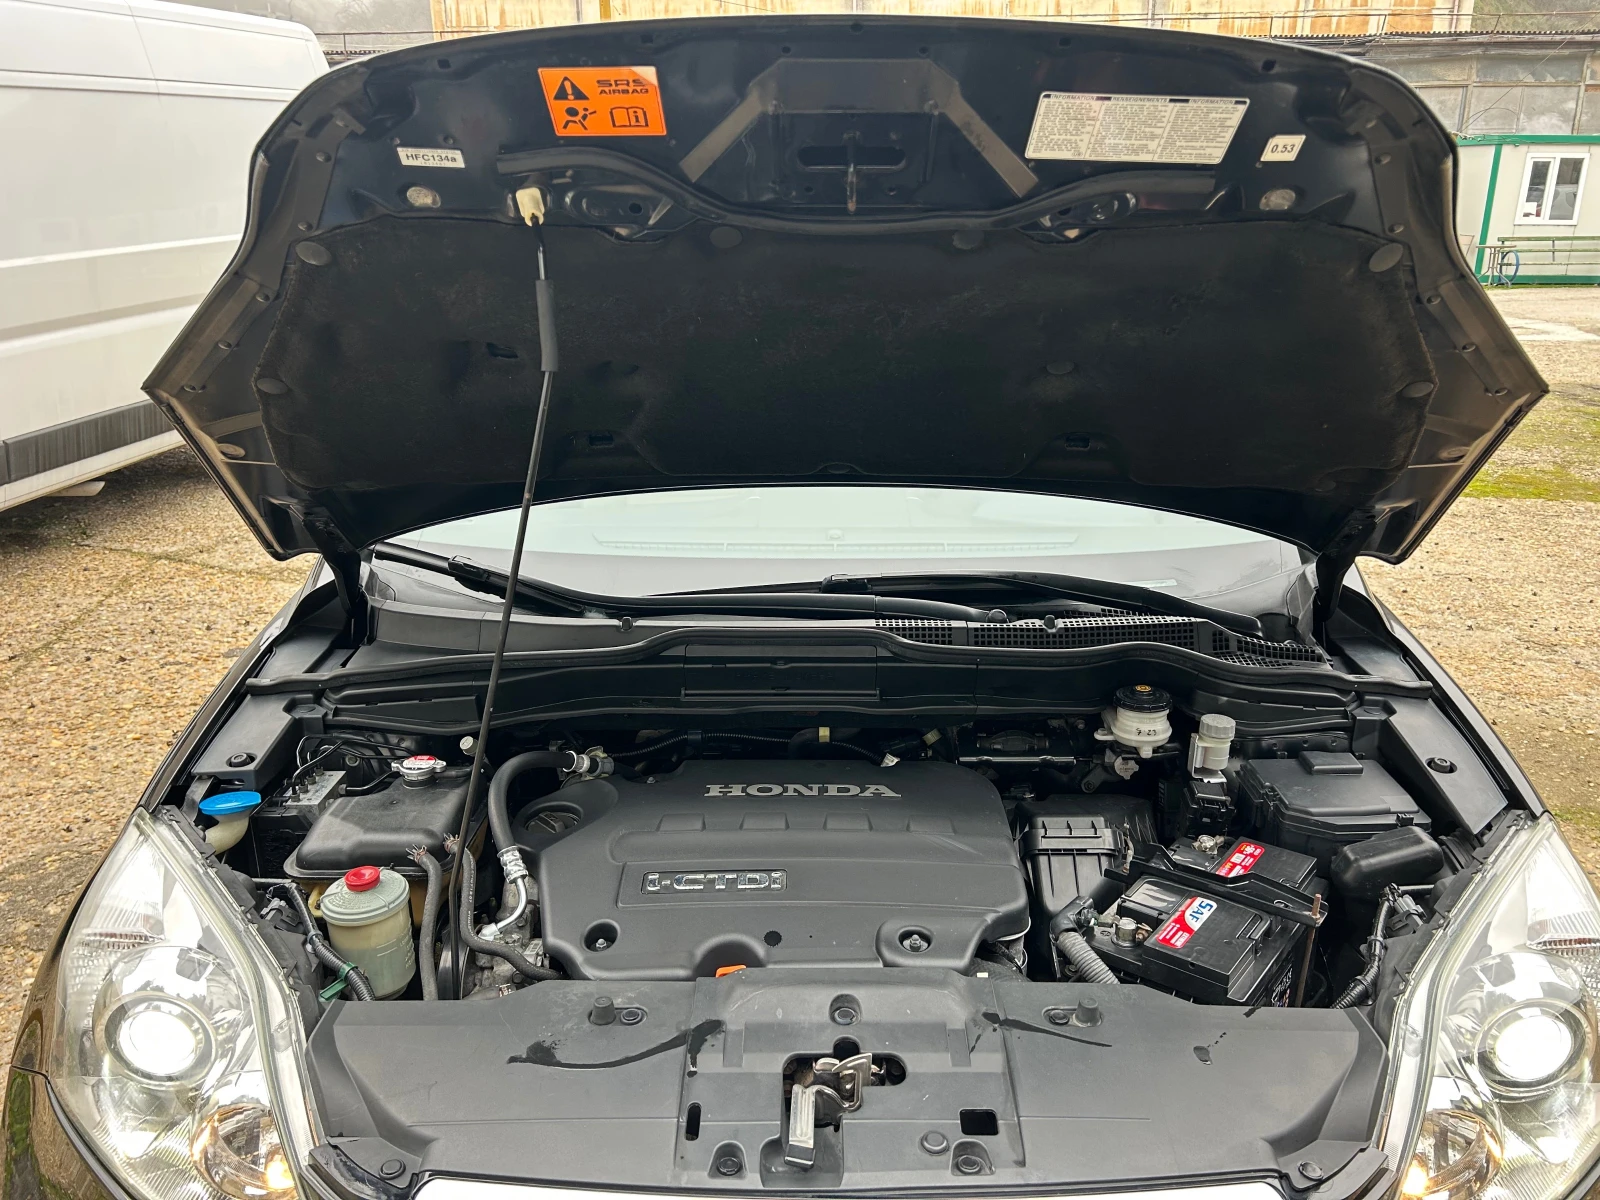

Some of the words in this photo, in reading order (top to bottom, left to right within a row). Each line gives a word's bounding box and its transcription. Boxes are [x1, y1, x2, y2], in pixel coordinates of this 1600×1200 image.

[596, 79, 646, 88] SRS
[1270, 143, 1296, 154] 0.53
[405, 153, 457, 163] HFC134a
[704, 783, 902, 798] HONDA
